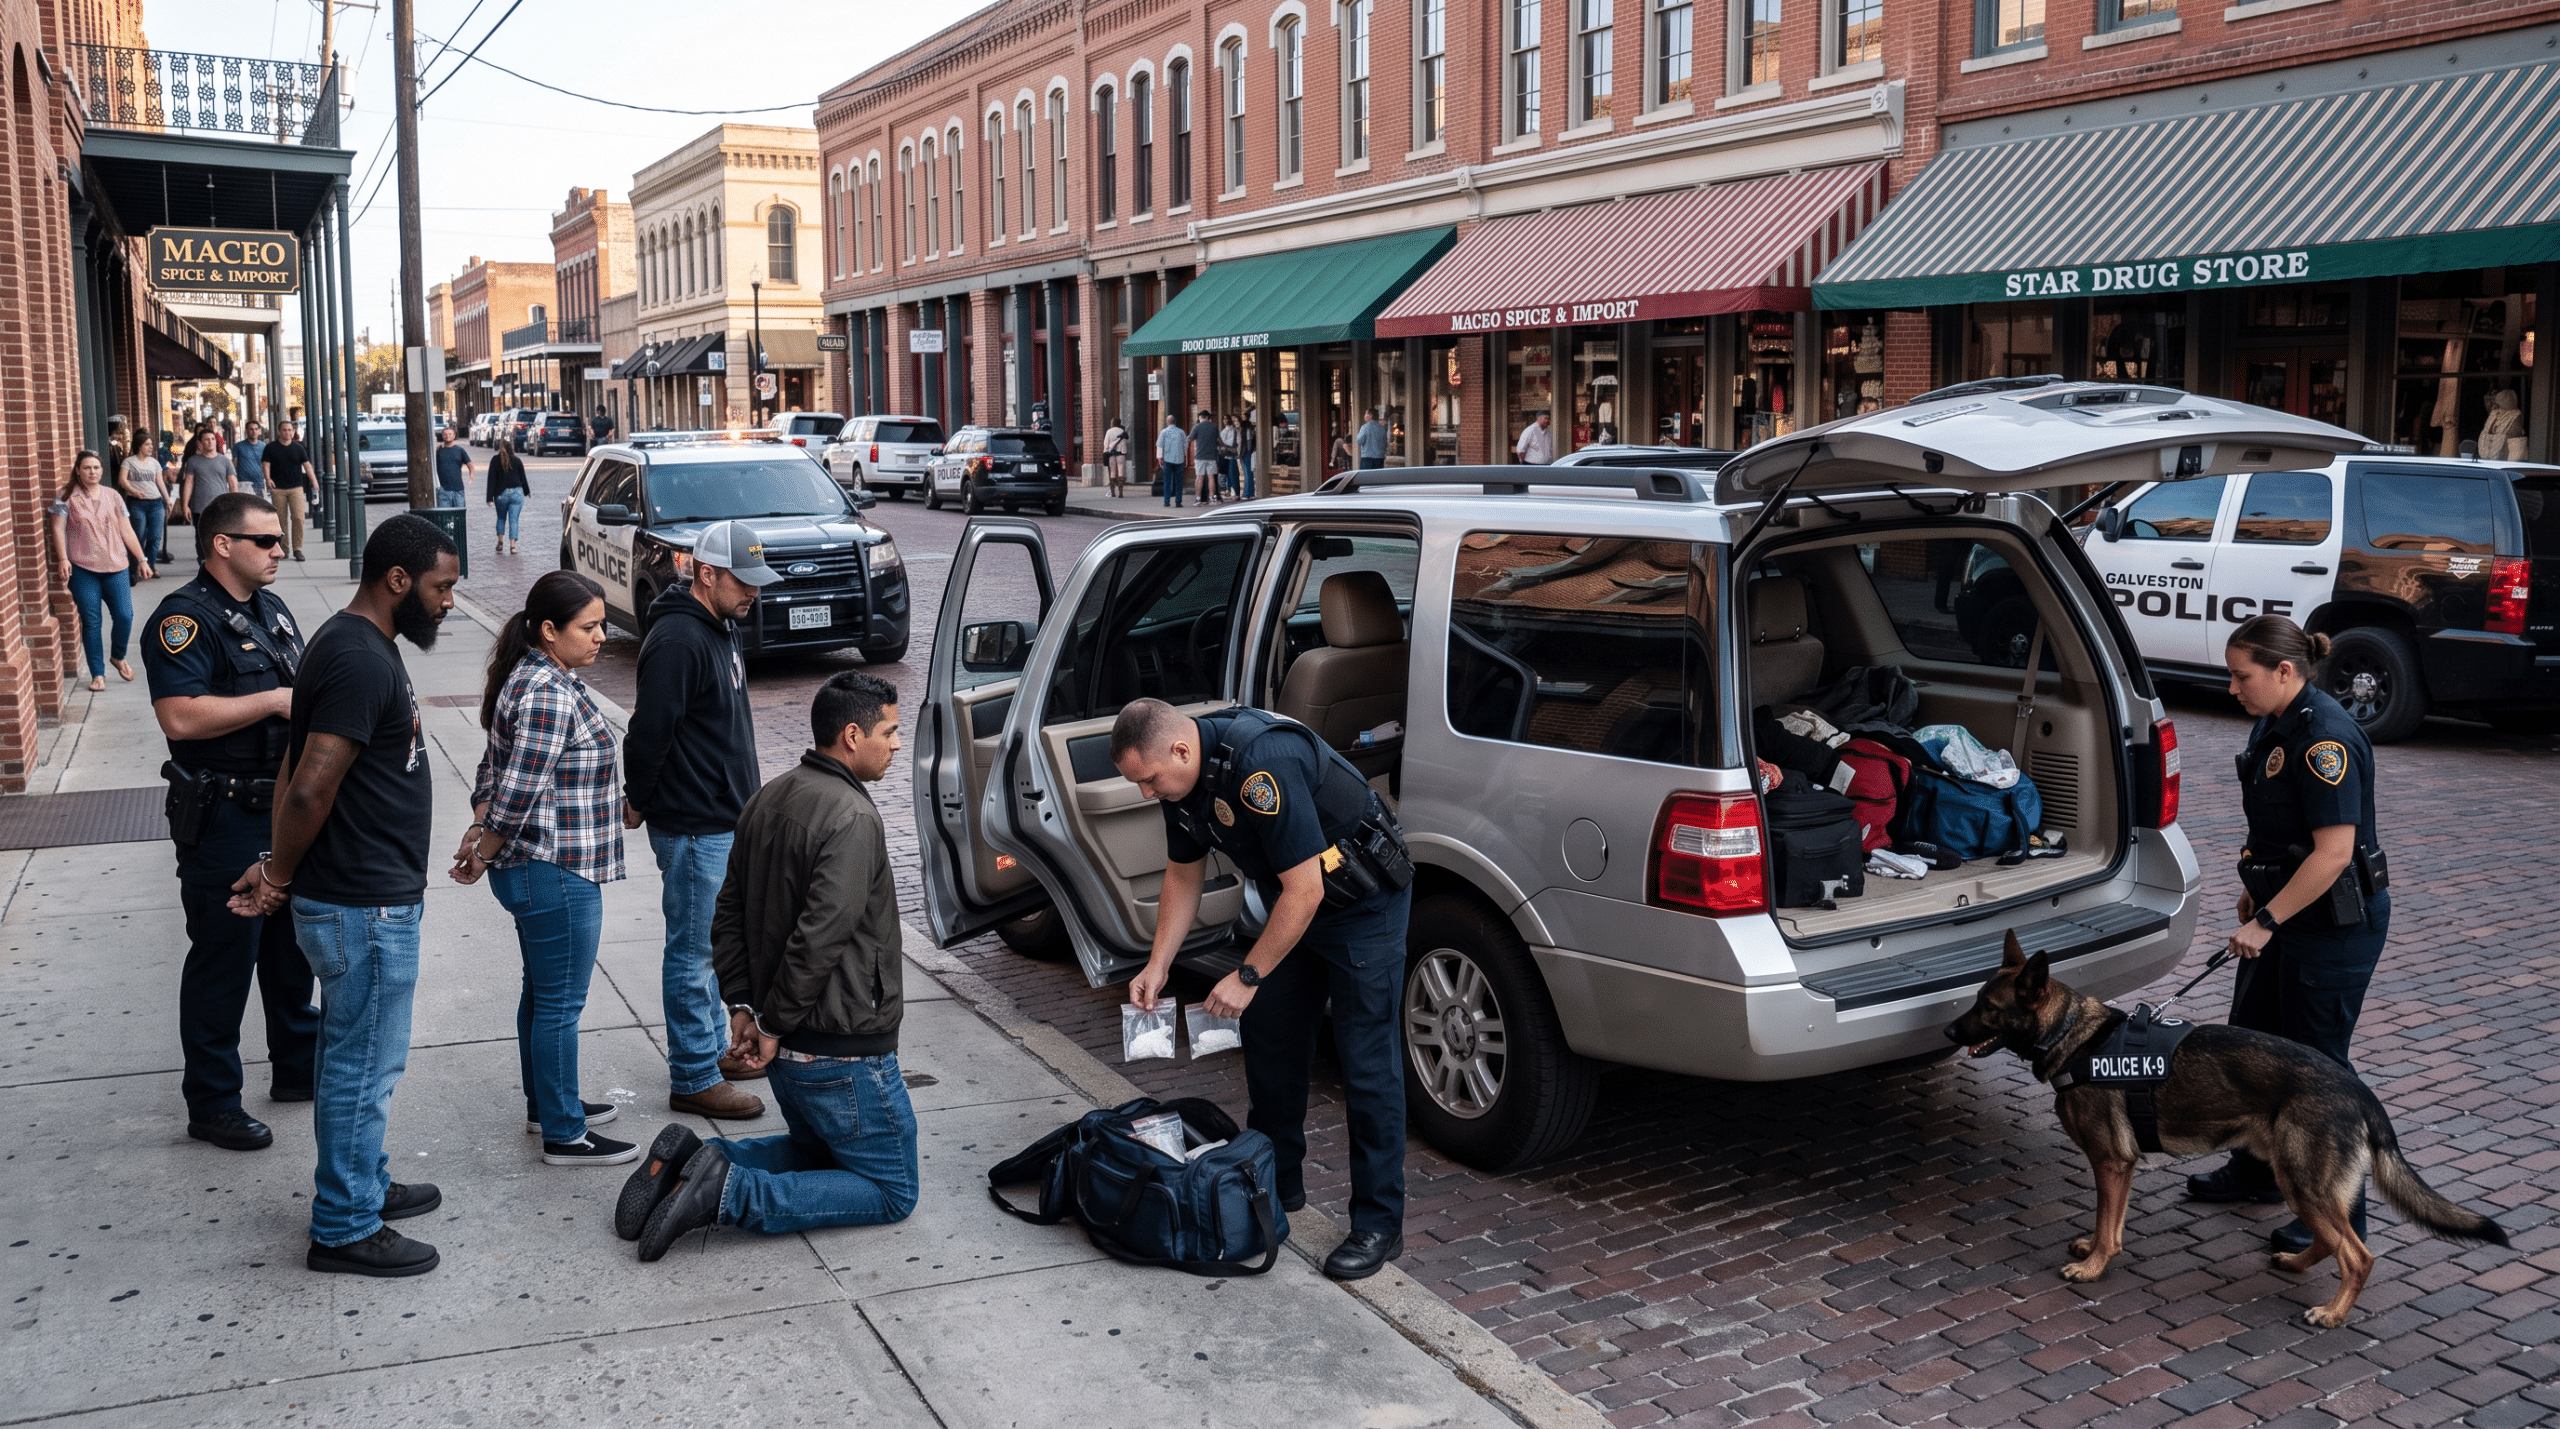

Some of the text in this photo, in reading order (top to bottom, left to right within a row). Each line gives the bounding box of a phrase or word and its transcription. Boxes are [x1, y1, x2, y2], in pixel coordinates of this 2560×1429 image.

[162, 238, 286, 266] MACEO
[161, 268, 289, 283] SPICE & IMPORT
[2006, 252, 2309, 297] STAR DRUG STORE
[1451, 300, 1639, 331] MACEO SPICE & IMPORT
[578, 539, 627, 588] POLICE
[2105, 572, 2203, 590] GALVESTON
[2108, 588, 2294, 624] POLICE
[2092, 1056, 2165, 1077] POLICE K-9
